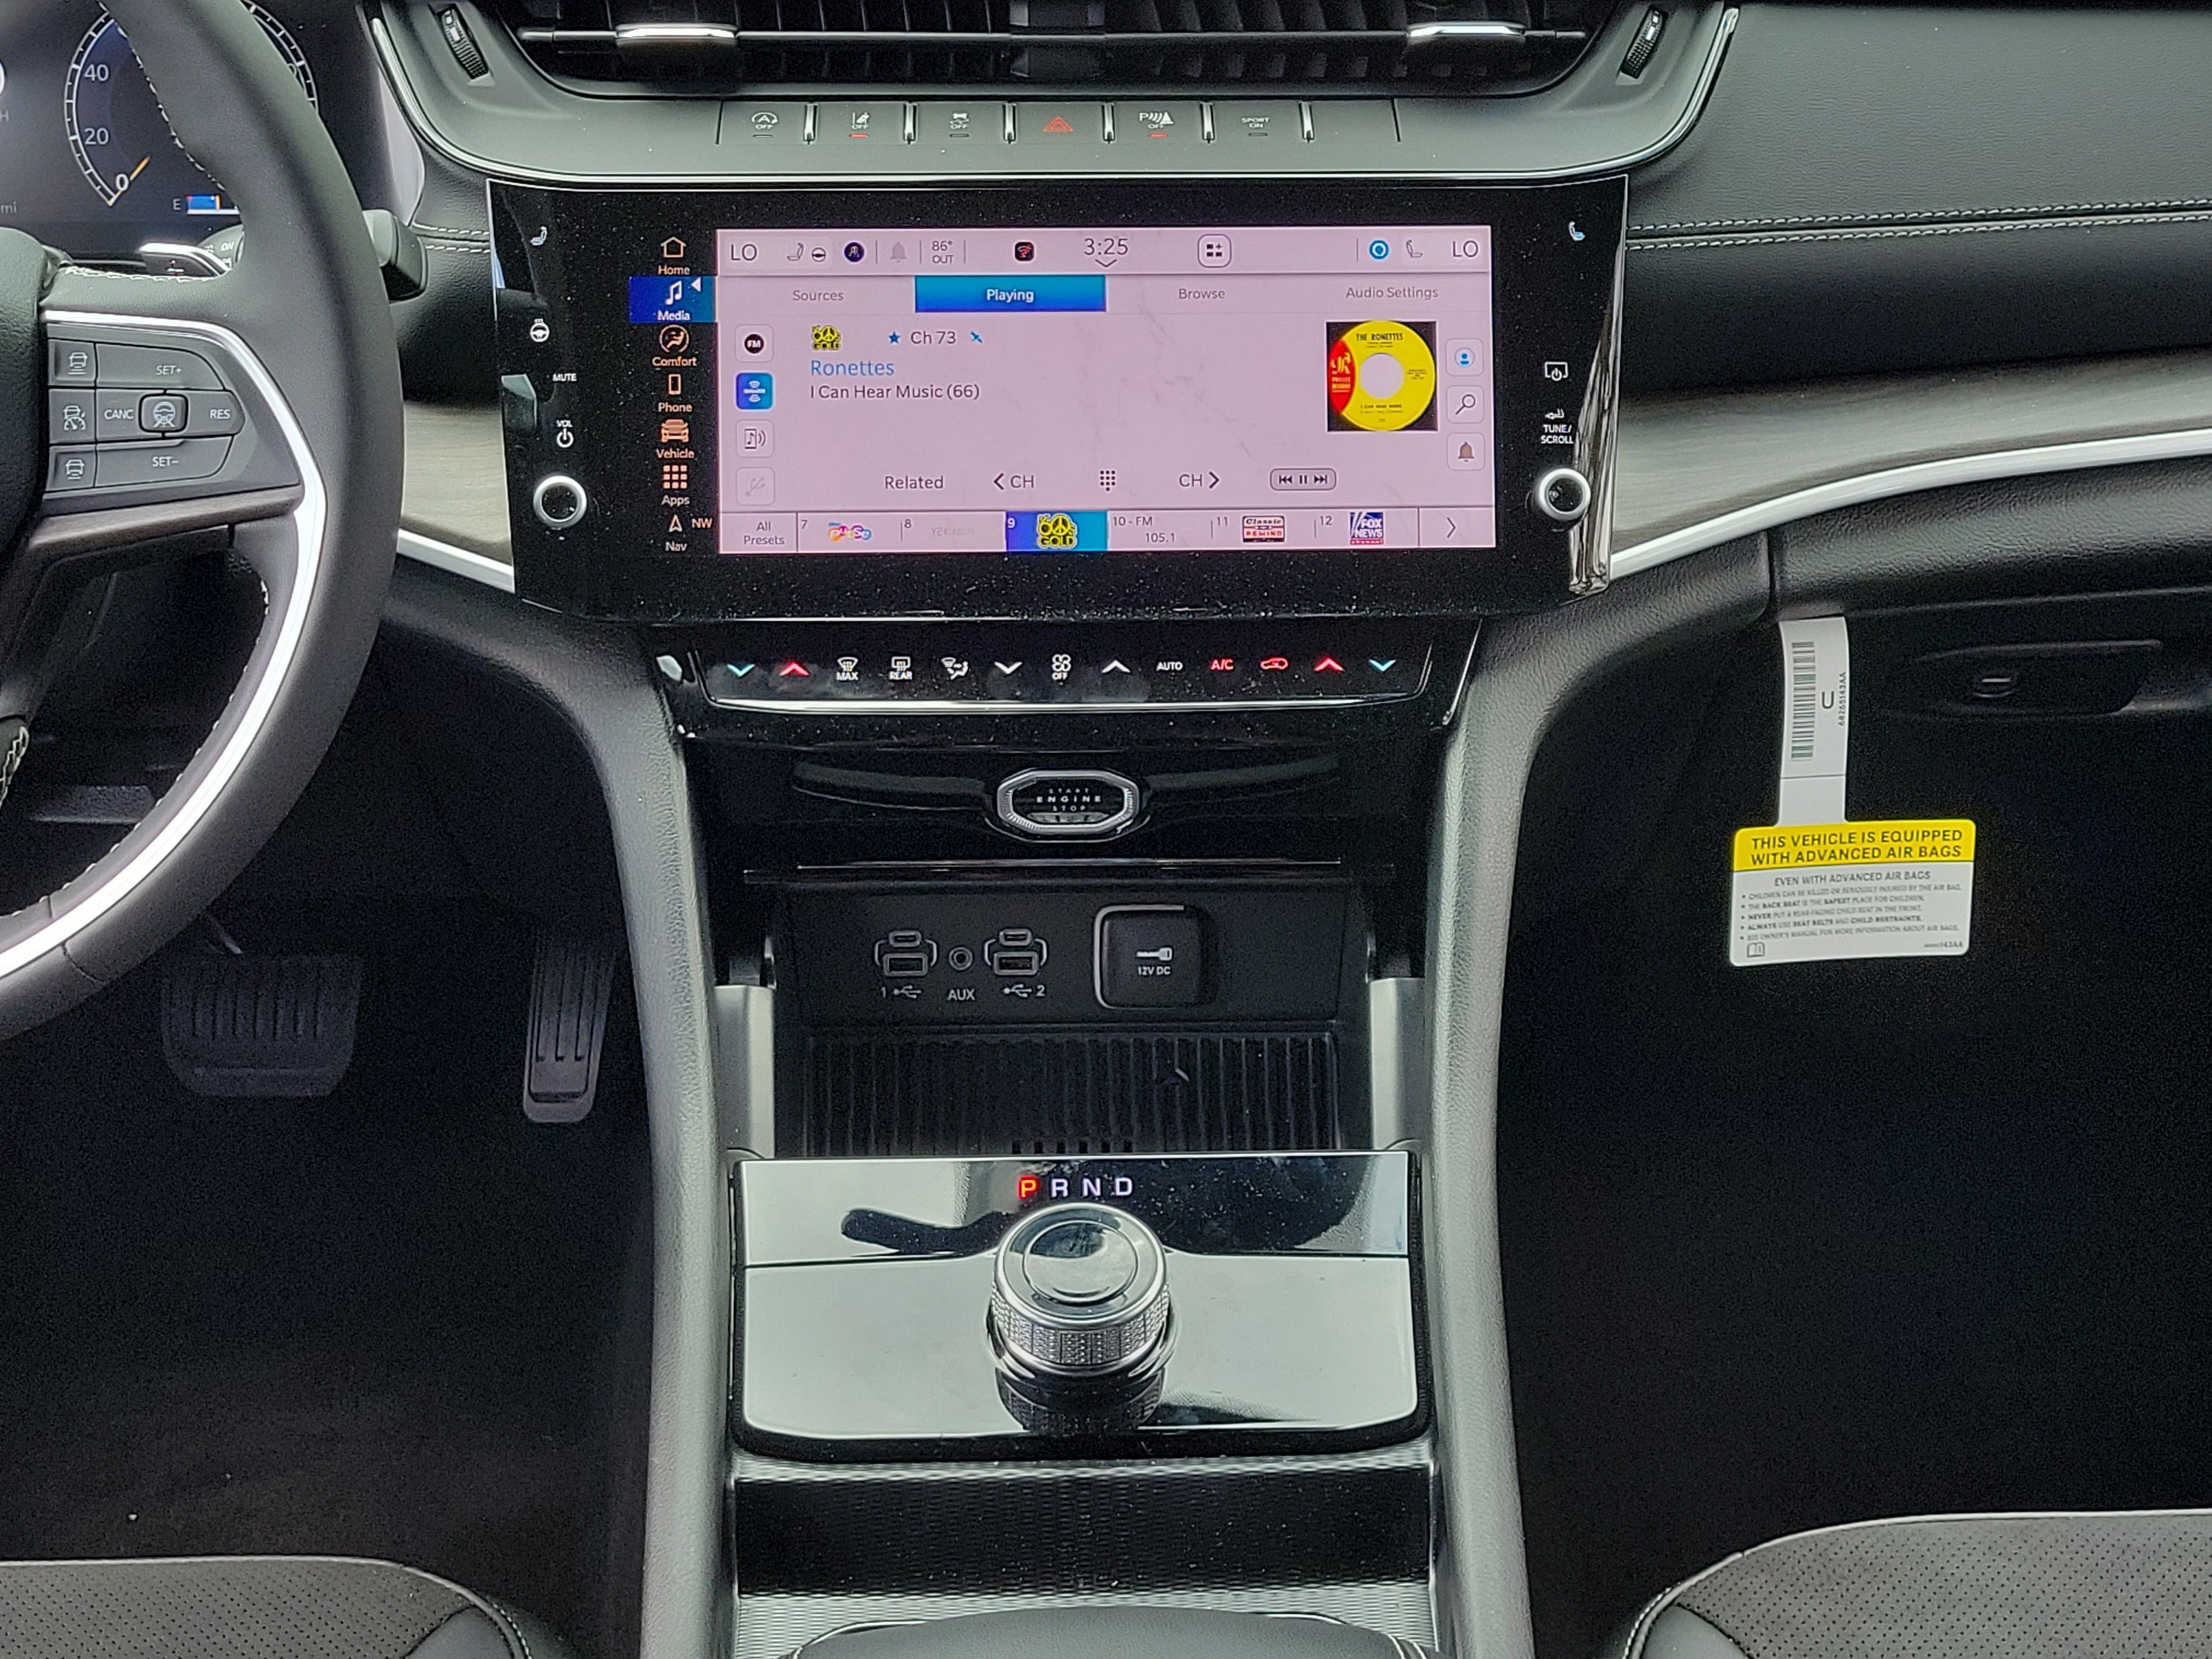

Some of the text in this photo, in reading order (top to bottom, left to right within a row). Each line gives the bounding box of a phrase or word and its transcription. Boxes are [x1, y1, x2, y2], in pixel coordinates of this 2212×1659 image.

[84, 64, 109, 82] 40
[84, 128, 109, 145] 20
[115, 173, 129, 192] 0
[1, 202, 17, 214] mi
[172, 199, 181, 210] E
[932, 240, 953, 251] 86°
[1084, 238, 1129, 256] 3:25
[1452, 240, 1479, 258] LO
[730, 244, 757, 261] LO
[932, 255, 954, 264] OUT
[658, 266, 690, 275] Home
[793, 290, 844, 301] Sources
[986, 289, 1035, 303] Playing
[1178, 289, 1226, 300] Browse
[1346, 286, 1439, 300] Audio Settings
[657, 311, 690, 320] Media
[910, 331, 956, 345] Ch 73
[652, 357, 697, 366] Comfort
[156, 365, 183, 375] SET+
[811, 360, 895, 376] Ronettes
[552, 373, 577, 381] MUTE
[811, 385, 980, 400] I Can Hear Music (66)
[658, 403, 692, 412] Phone
[104, 409, 134, 419] CANC
[210, 409, 230, 419] RES
[1541, 435, 1574, 444] SCROLL
[657, 449, 694, 459] Vehicle
[885, 476, 944, 489] Related
[1010, 475, 1035, 489] CH
[1179, 474, 1203, 487] CH
[662, 495, 690, 506] Apps
[691, 518, 712, 528] NW
[801, 520, 808, 529] 7
[904, 519, 912, 528] 8
[1008, 518, 1015, 528] 9
[1113, 517, 1126, 526] 10
[1136, 517, 1153, 526] FM
[1216, 517, 1228, 526] 11
[1320, 516, 1332, 525] 12
[1361, 518, 1382, 528] FOX
[757, 522, 771, 531] All
[1355, 528, 1383, 537] NEWS
[744, 535, 785, 545] Presets
[1039, 536, 1077, 546] GOLD
[1146, 533, 1176, 543] 105.1
[665, 541, 687, 551] Nav
[1156, 662, 1183, 671] AUTO
[1211, 659, 1234, 670] A/C
[837, 672, 859, 680] MAX
[889, 672, 912, 680] REAR
[1821, 691, 1835, 709] U
[1752, 830, 1962, 850] THIS VEHICLE IS EQUIPPED
[1751, 845, 1962, 865] WITH ADVANCED AIR BAGS
[1775, 871, 1931, 886] EVEN WITH ADVANCED AIR BAGS
[1138, 966, 1171, 975] 12V DC
[881, 987, 886, 997] 1
[947, 989, 975, 1001] AUX
[1036, 985, 1045, 996] 2
[1021, 1177, 1133, 1198] P R N D
